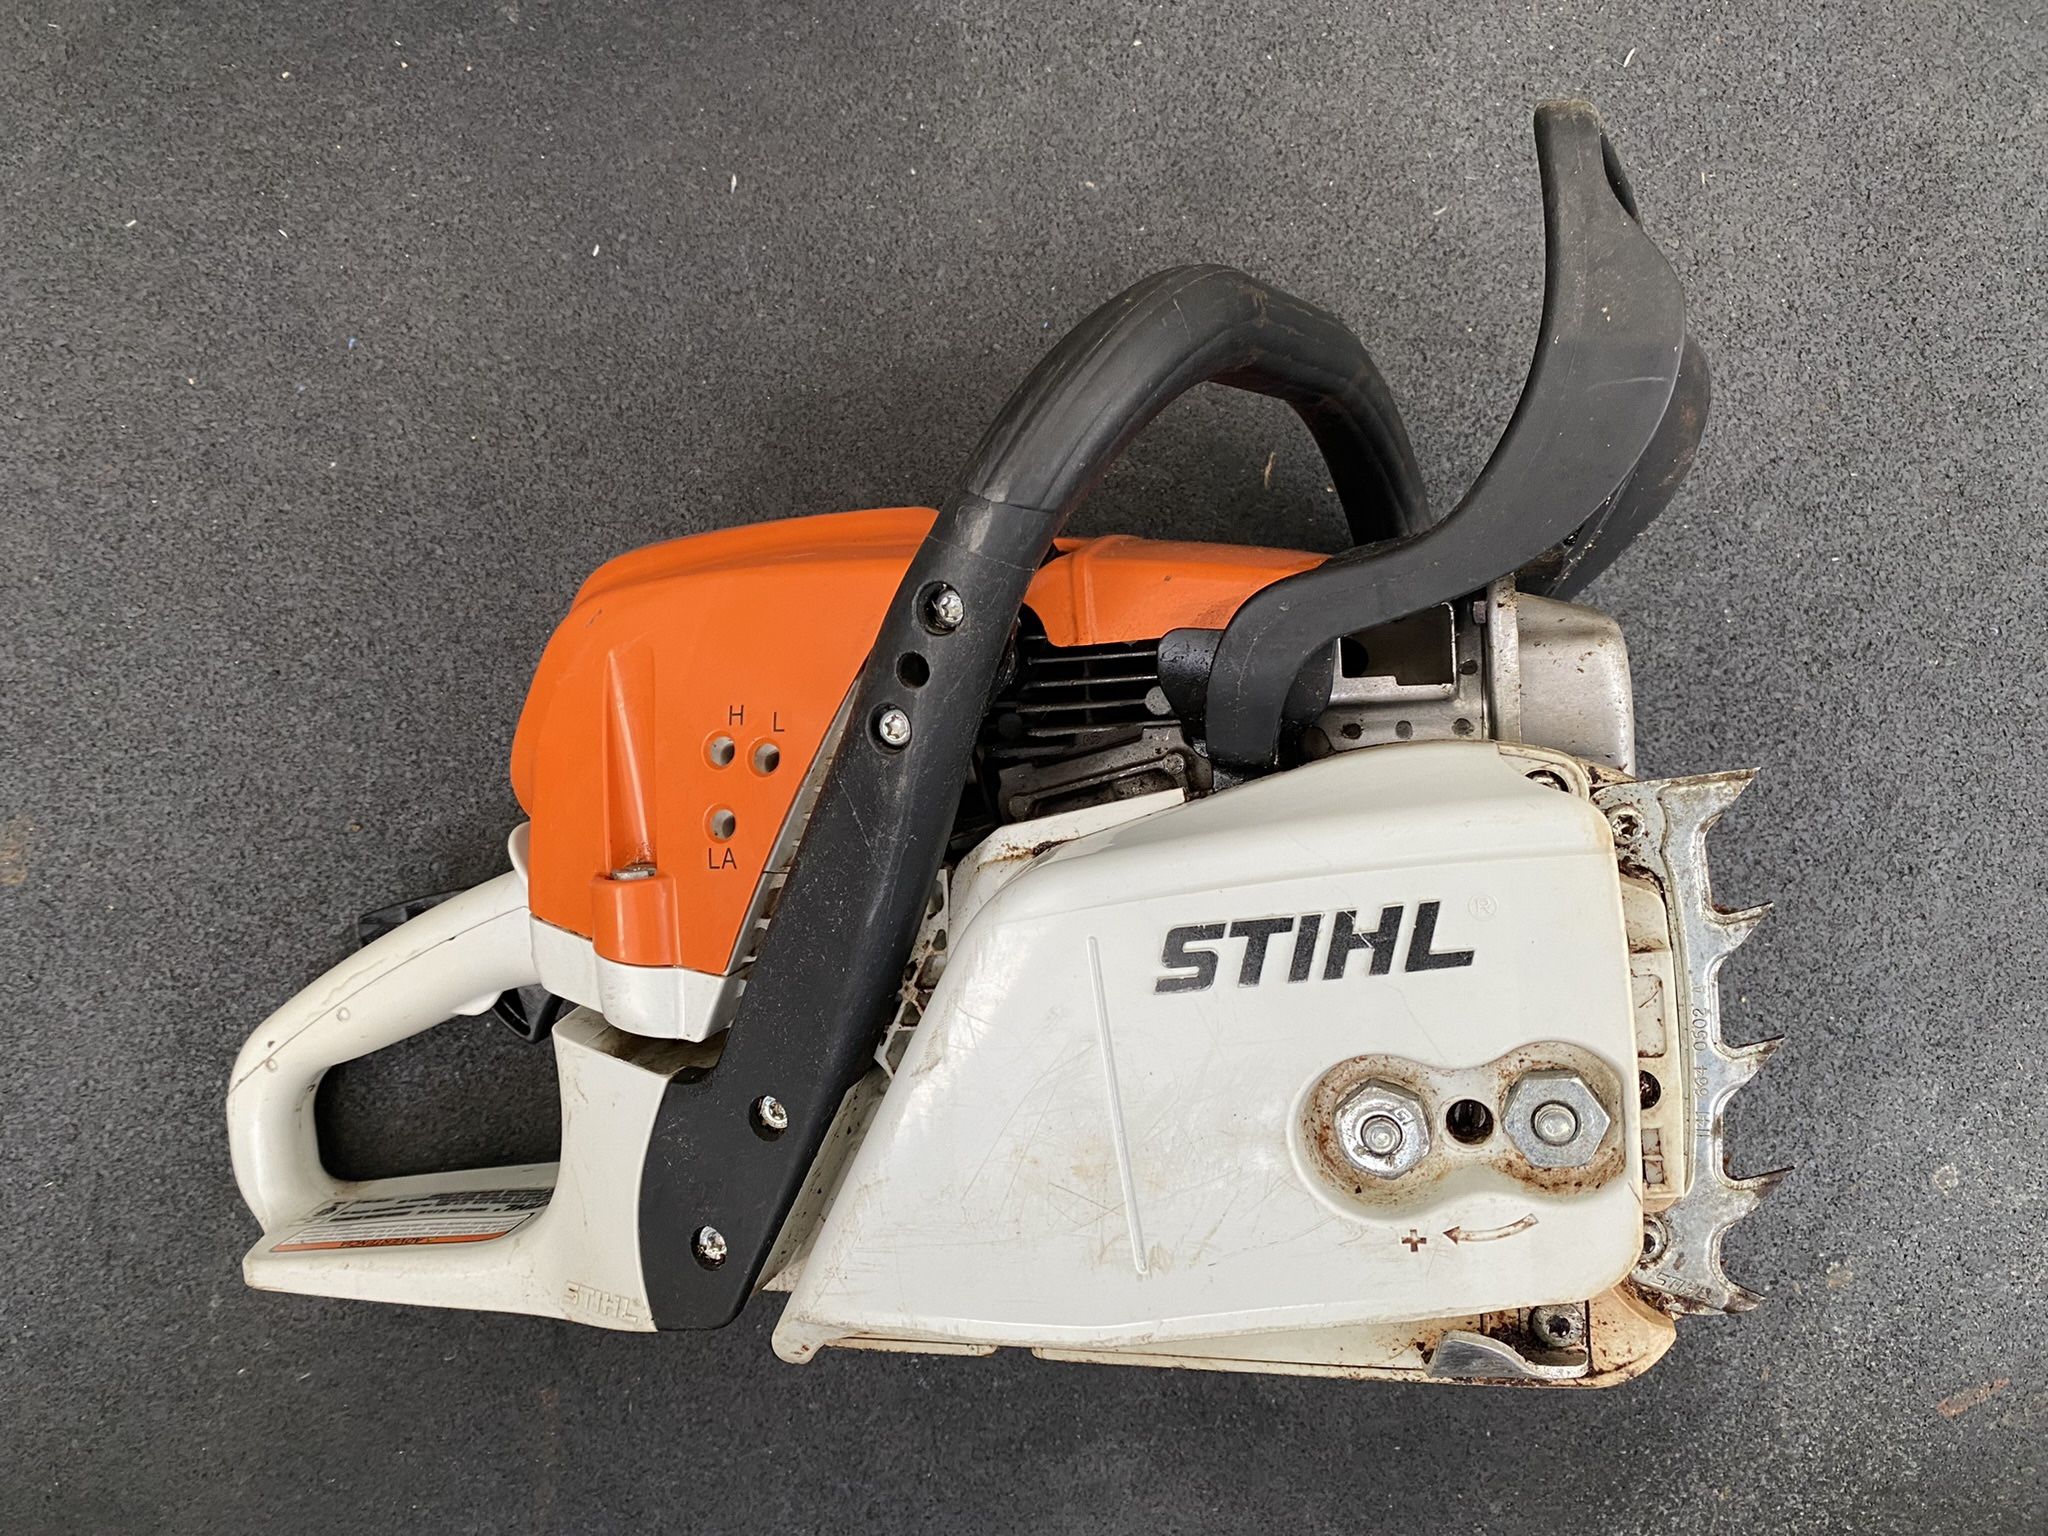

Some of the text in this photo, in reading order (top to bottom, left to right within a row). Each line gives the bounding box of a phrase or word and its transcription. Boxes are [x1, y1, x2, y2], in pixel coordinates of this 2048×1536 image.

[728, 704, 745, 726] H
[772, 711, 785, 733] L
[707, 847, 738, 870] LA
[1153, 899, 1476, 995] STIHL
[1692, 1007, 1709, 1051] 0502
[1694, 1064, 1710, 1097] 664
[562, 1280, 640, 1323] STIHL
